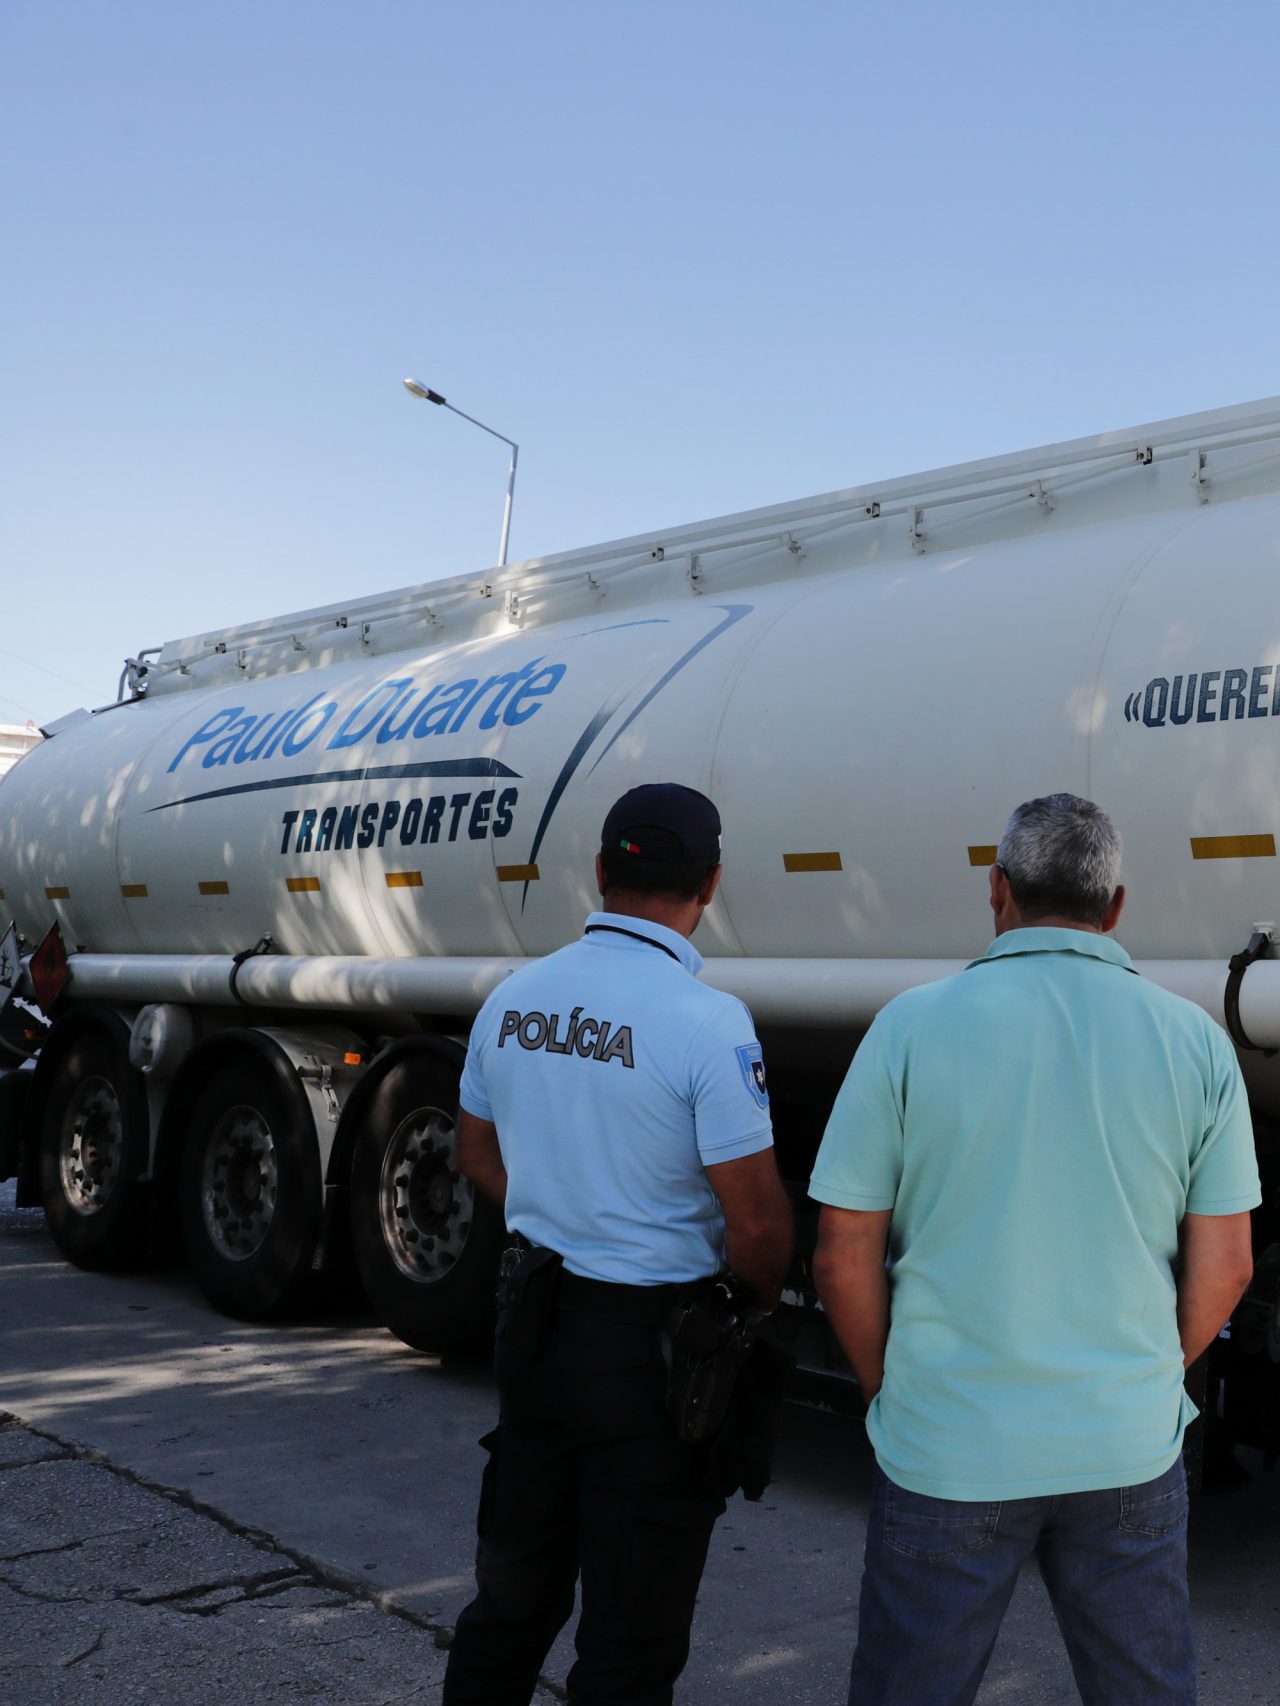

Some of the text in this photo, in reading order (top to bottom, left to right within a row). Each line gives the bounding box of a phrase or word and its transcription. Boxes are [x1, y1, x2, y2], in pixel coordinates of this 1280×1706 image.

[166, 654, 568, 774] Paulo Duarte
[280, 787, 519, 855] TRANSPORTES
[498, 1006, 636, 1069] POLÍCIA
